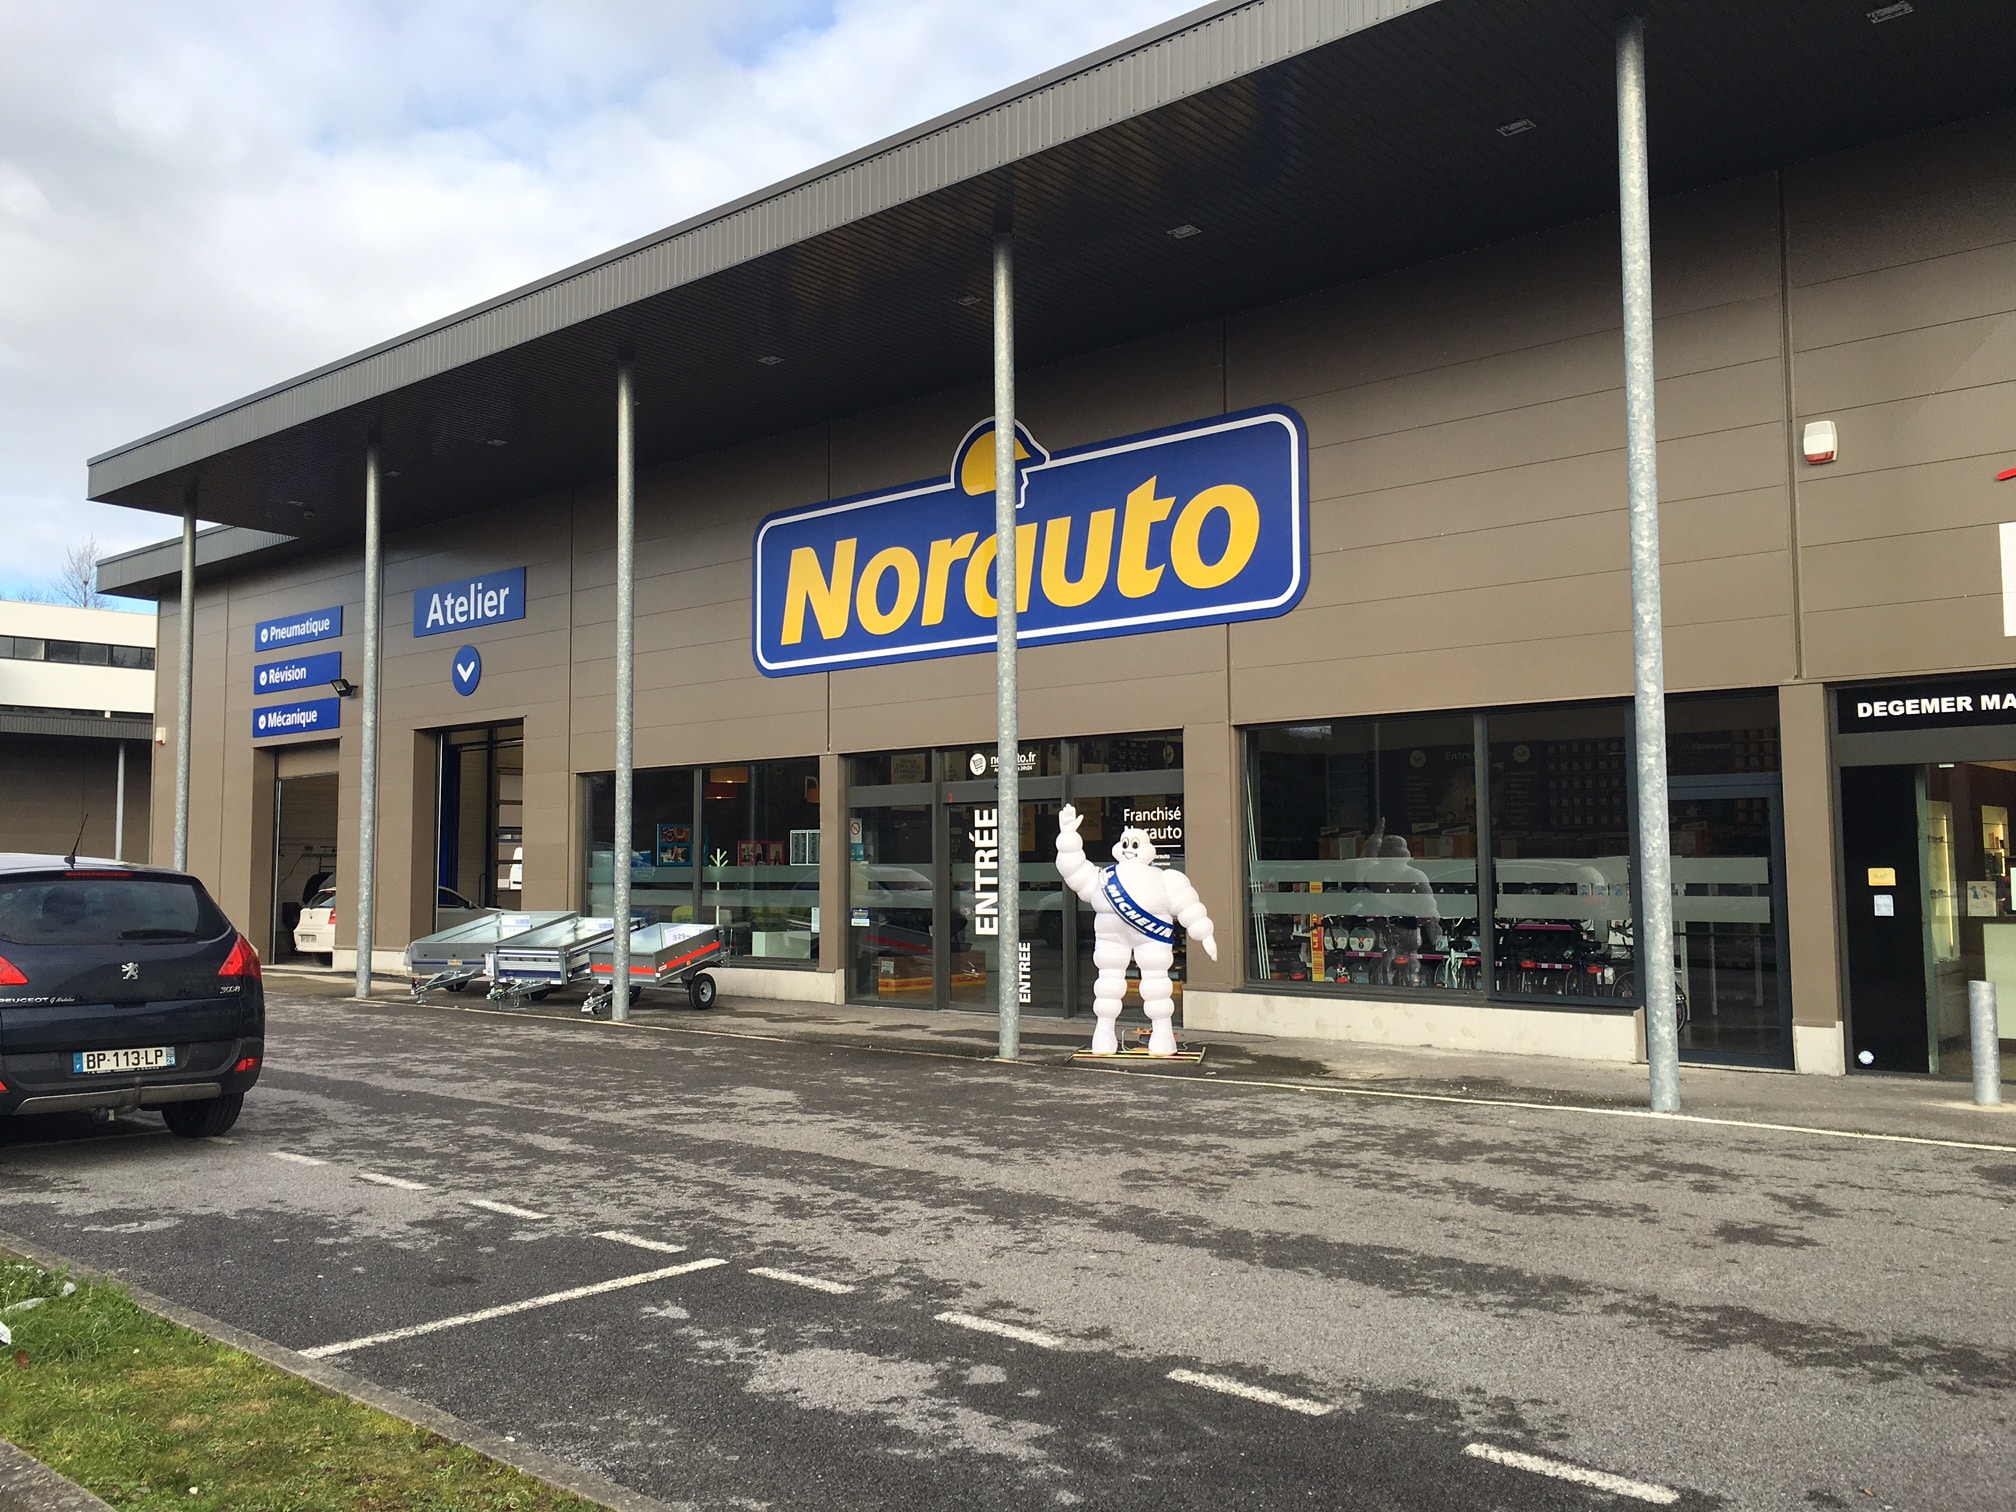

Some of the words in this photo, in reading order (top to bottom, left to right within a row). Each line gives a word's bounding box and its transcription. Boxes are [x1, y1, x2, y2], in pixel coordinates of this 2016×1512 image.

[425, 582, 510, 628] Atelier
[269, 616, 330, 641] Pneumatique
[268, 664, 307, 683] Révision
[1857, 696, 1973, 718] DEGEMER
[267, 709, 318, 728] Mécanique
[1123, 806, 1182, 822] Franchisé
[968, 808, 998, 936] ENTRÉE
[1107, 883, 1174, 939] MICHELIN
[166, 1057, 175, 1065] 29
